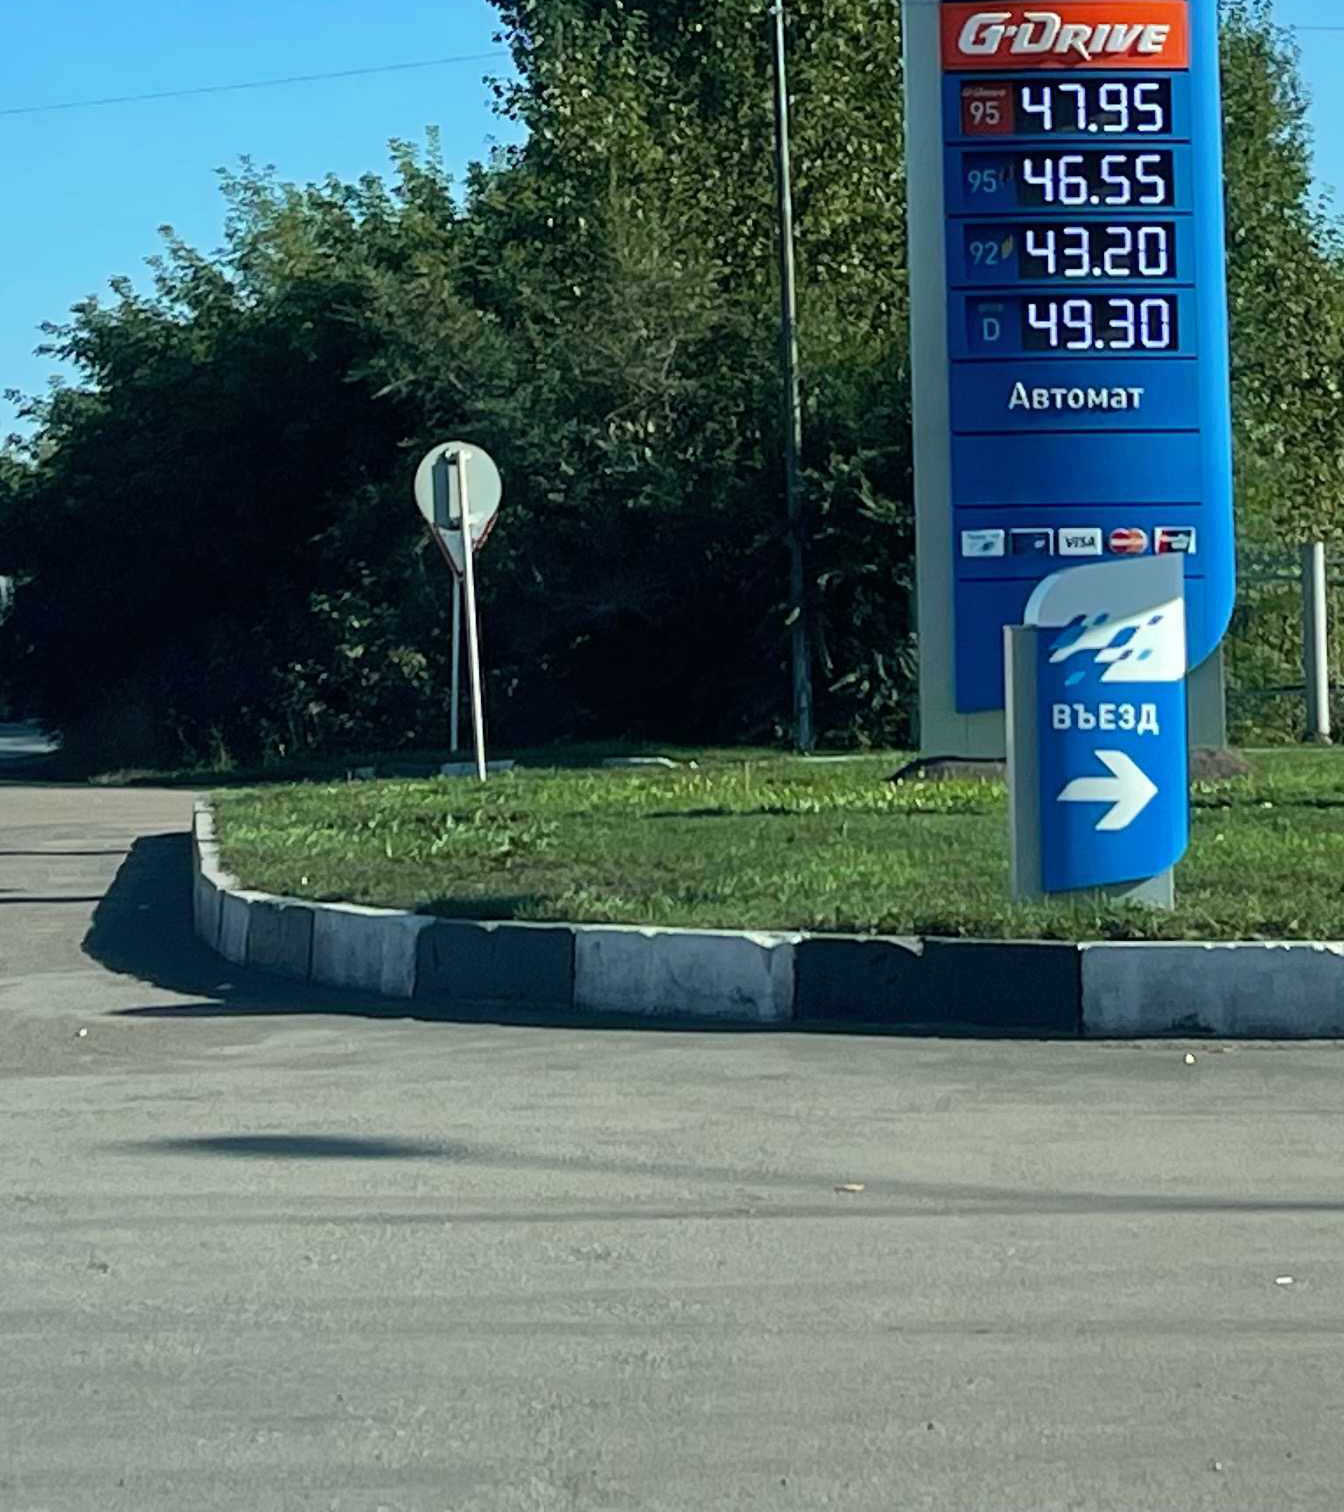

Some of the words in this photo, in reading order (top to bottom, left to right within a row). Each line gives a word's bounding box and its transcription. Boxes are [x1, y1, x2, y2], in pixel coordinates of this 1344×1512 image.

[970, 102, 1000, 125] 95
[1021, 83, 1164, 133] 47.95
[968, 170, 997, 193] 95
[1023, 154, 1166, 206] 46.55
[969, 242, 999, 266] 92
[1025, 226, 1168, 278] 43.20
[1028, 298, 1170, 350] 49.30
[1008, 382, 1144, 410] Автомат
[1064, 535, 1096, 549] VISA
[1052, 703, 1159, 736] ВЪЕЗД
